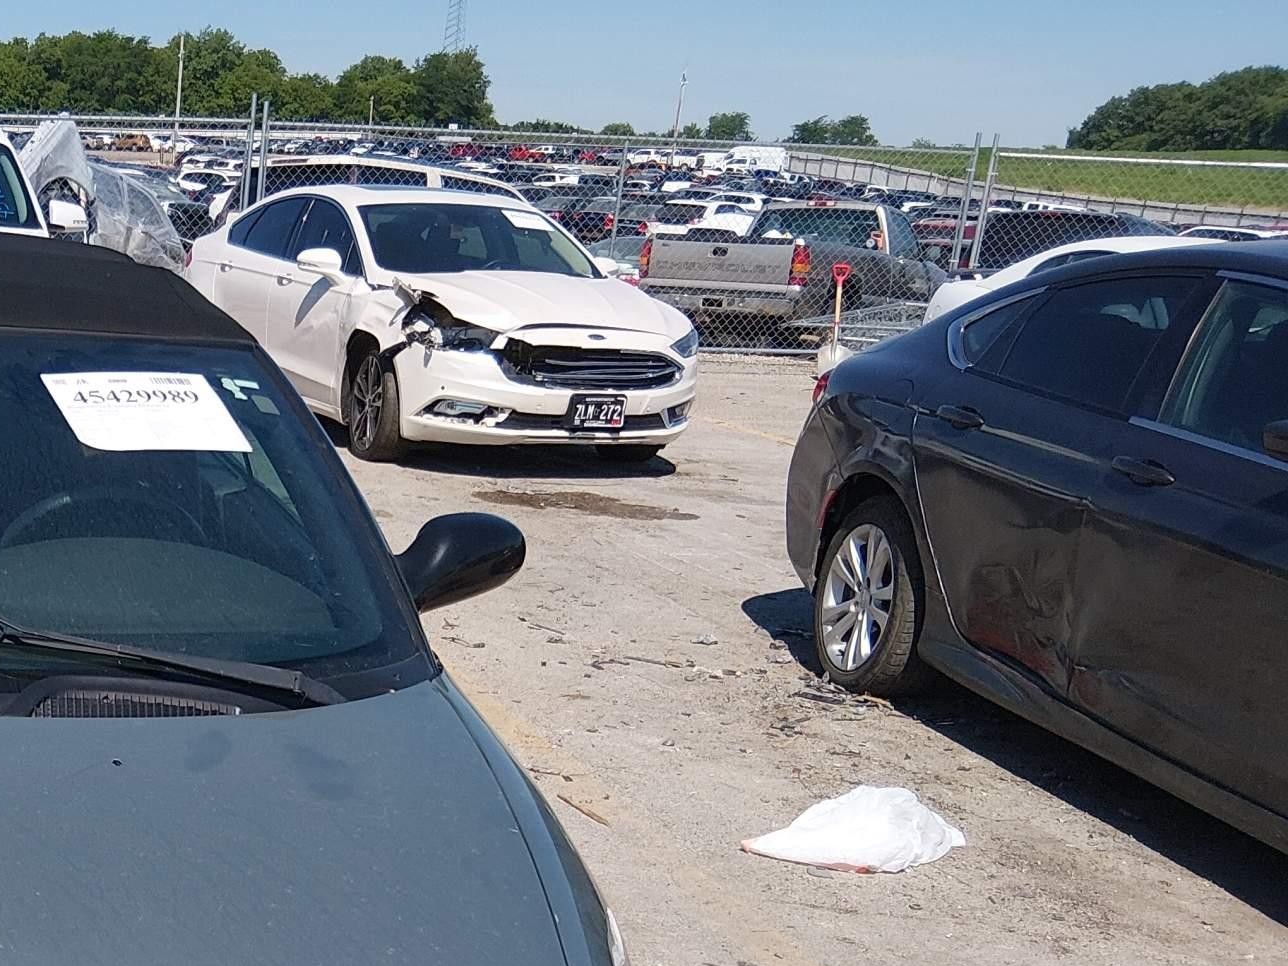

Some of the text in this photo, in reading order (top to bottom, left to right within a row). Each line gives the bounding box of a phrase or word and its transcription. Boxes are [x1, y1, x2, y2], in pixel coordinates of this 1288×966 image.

[656, 259, 781, 273] CHEVROLET
[73, 388, 200, 405] 45429989
[599, 404, 622, 420] 272
